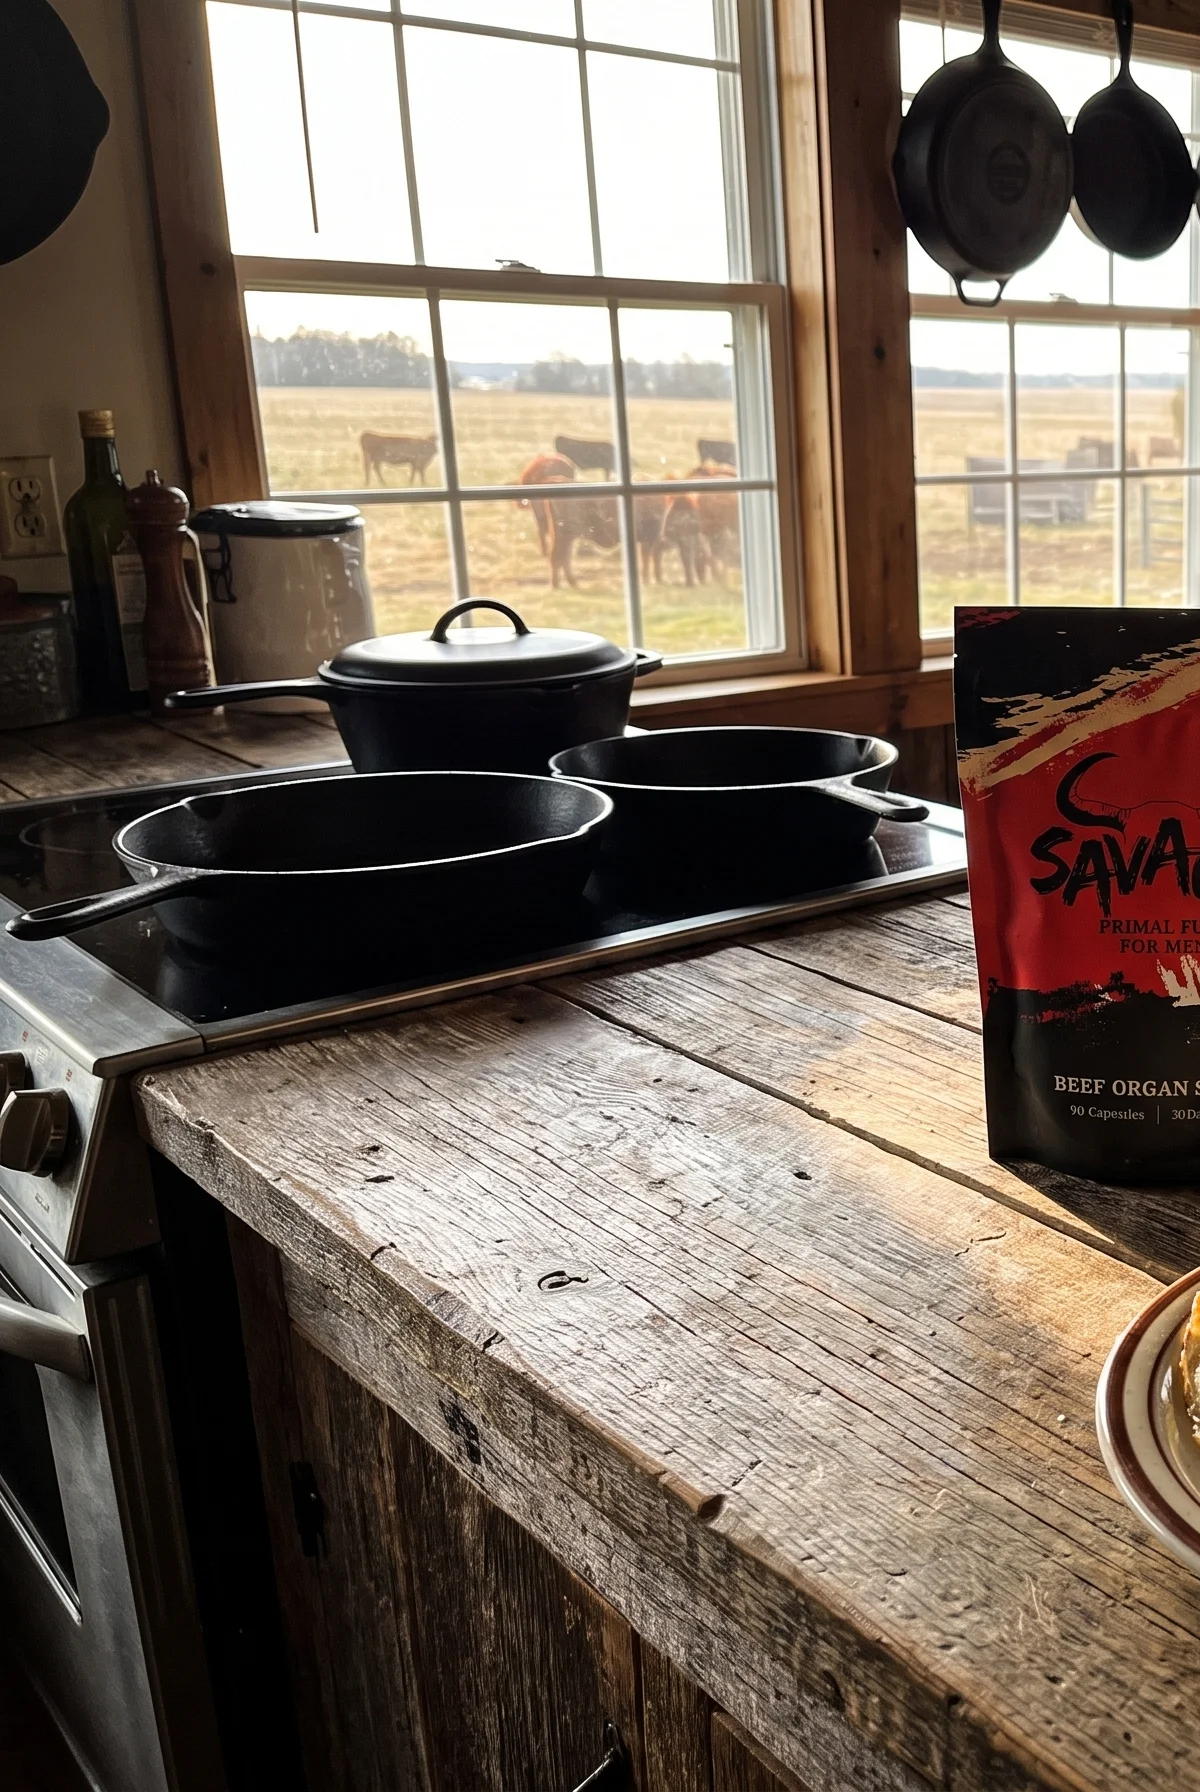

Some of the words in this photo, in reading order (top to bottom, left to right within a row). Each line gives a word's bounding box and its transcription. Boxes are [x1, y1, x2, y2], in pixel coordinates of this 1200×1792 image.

[1099, 919, 1175, 935] PRIMAL
[1120, 938, 1159, 954] FOR
[1054, 1075, 1106, 1095] BEEF
[1112, 1079, 1189, 1097] ORGAN
[1070, 1104, 1085, 1117] 90
